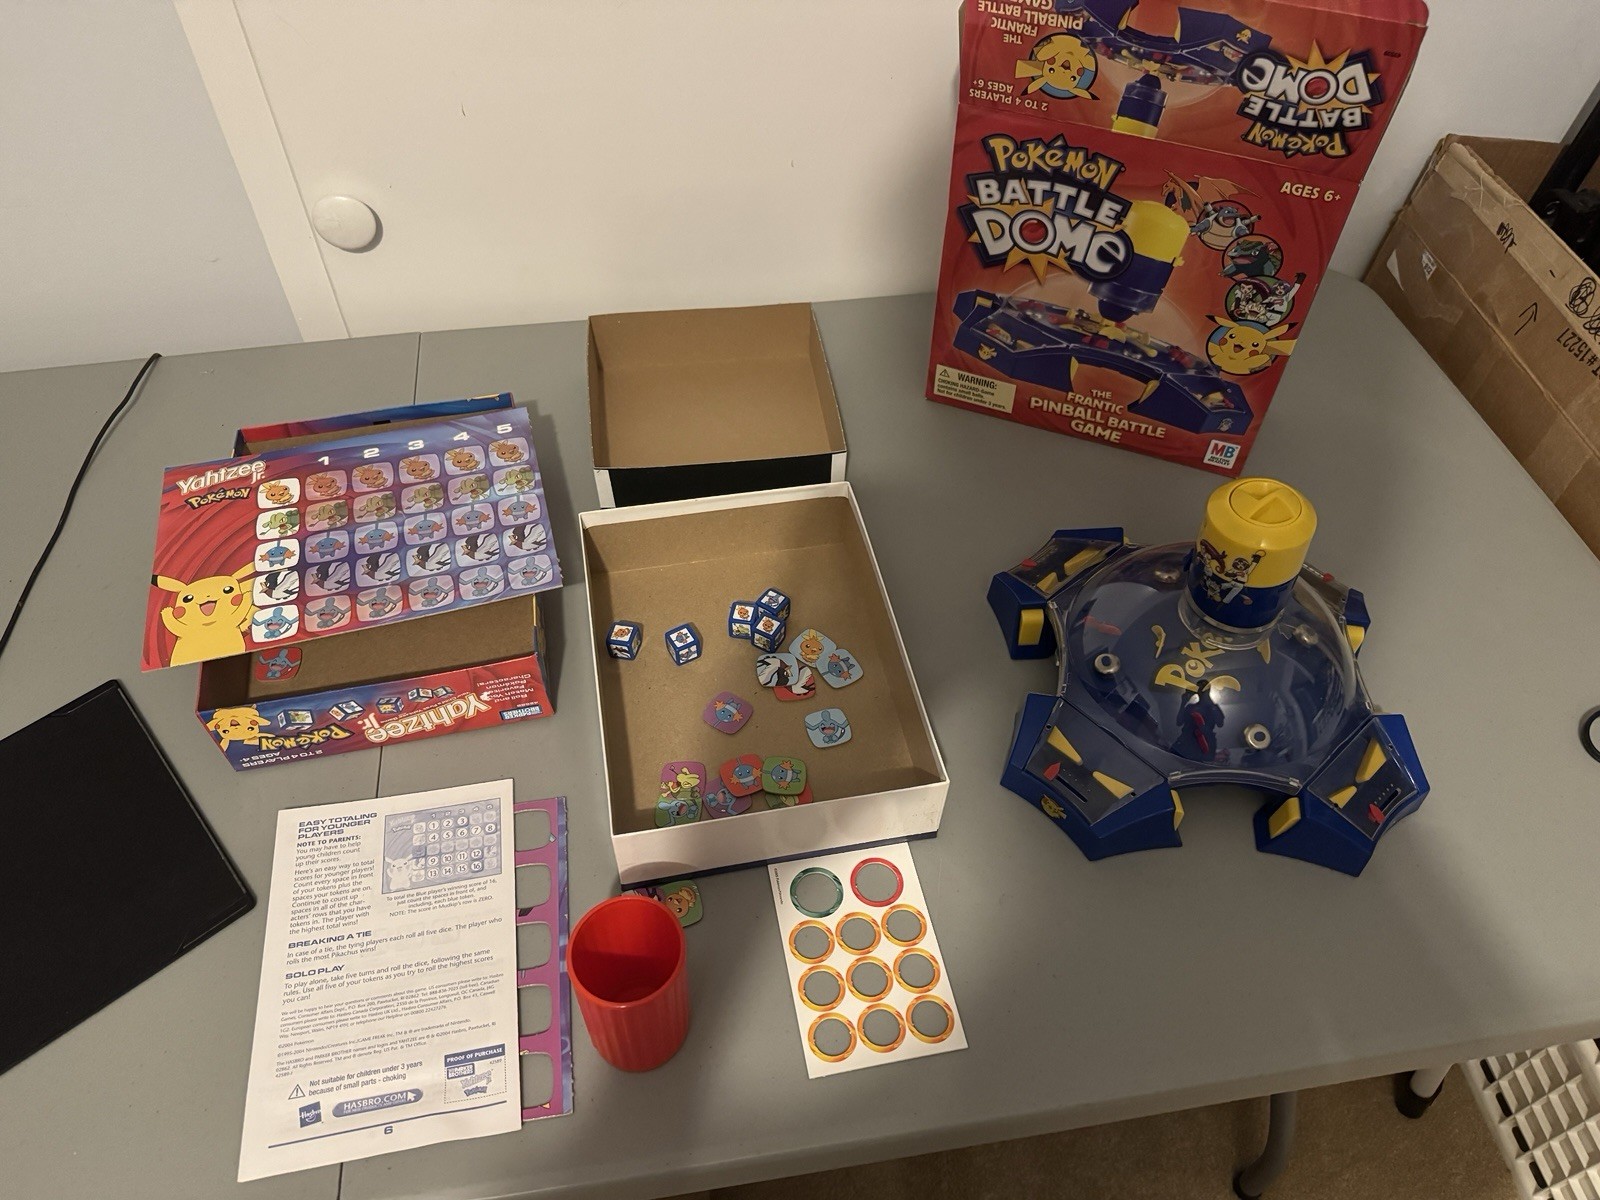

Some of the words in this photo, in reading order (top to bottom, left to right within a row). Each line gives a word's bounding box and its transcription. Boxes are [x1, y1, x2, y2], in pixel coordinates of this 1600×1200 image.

[978, 1, 1021, 17] BATTLE
[991, 17, 1038, 37] FRANTIC
[1024, 10, 1083, 30] PINBALL
[1003, 34, 1022, 44] THE
[973, 79, 985, 88] 6+
[988, 81, 1013, 94] AGES
[969, 88, 1012, 105] PLAYERS
[1015, 97, 1022, 106] 4
[1025, 100, 1038, 110] TO
[1041, 102, 1048, 111] 2
[1244, 94, 1363, 128] BATTLE
[1247, 121, 1348, 157] Pokémon
[988, 137, 1119, 190] Pokémon
[1280, 182, 1320, 199] AGES
[1324, 190, 1341, 201] 6+
[976, 178, 1124, 228] BATTLE
[957, 372, 997, 390] WARNING:
[1091, 389, 1112, 400] THE
[1066, 391, 1124, 415] FRANTIC
[1029, 397, 1105, 424] PINBALL
[1107, 415, 1166, 439] BATTLE
[1070, 419, 1123, 444] GAME
[318, 455, 330, 466] 1
[363, 447, 380, 459] 2
[408, 439, 425, 451] 3
[453, 431, 470, 441] 4
[496, 423, 513, 434] 5
[1211, 443, 1236, 458] MB
[176, 460, 267, 495] Yahtzee
[186, 486, 251, 508] Pokémon
[486, 679, 527, 689] Pokémon
[505, 688, 534, 696] Match
[365, 693, 492, 743] Yahtzee
[260, 725, 352, 750] Pokémon
[242, 755, 290, 768] PLAYERS
[251, 752, 281, 760] AGES
[298, 818, 326, 827] EASY
[328, 812, 377, 822] TOTALING
[321, 819, 370, 830] YOUNGER
[297, 828, 343, 839] PLAYERS
[328, 834, 360, 843] PARENTS:
[288, 935, 344, 948] BREAKING
[347, 941, 364, 950] tying
[365, 938, 387, 947] players
[468, 920, 486, 929] player
[331, 948, 358, 957] Pikachus
[359, 944, 376, 953] wins!
[285, 969, 316, 979] SOLO
[317, 964, 344, 974] PLAY
[293, 981, 307, 989] play
[430, 954, 460, 965] following
[474, 1048, 501, 1056] PURCHASE
[321, 1075, 345, 1084] suitable
[356, 1068, 380, 1077] children
[381, 1064, 399, 1073] under
[406, 1060, 422, 1070] years
[308, 1086, 334, 1096] because
[342, 1080, 359, 1089] small
[360, 1078, 376, 1087] parts
[382, 1073, 406, 1082] choking
[344, 1092, 405, 1110] HASBRO.COM
[383, 1125, 393, 1134] 6
